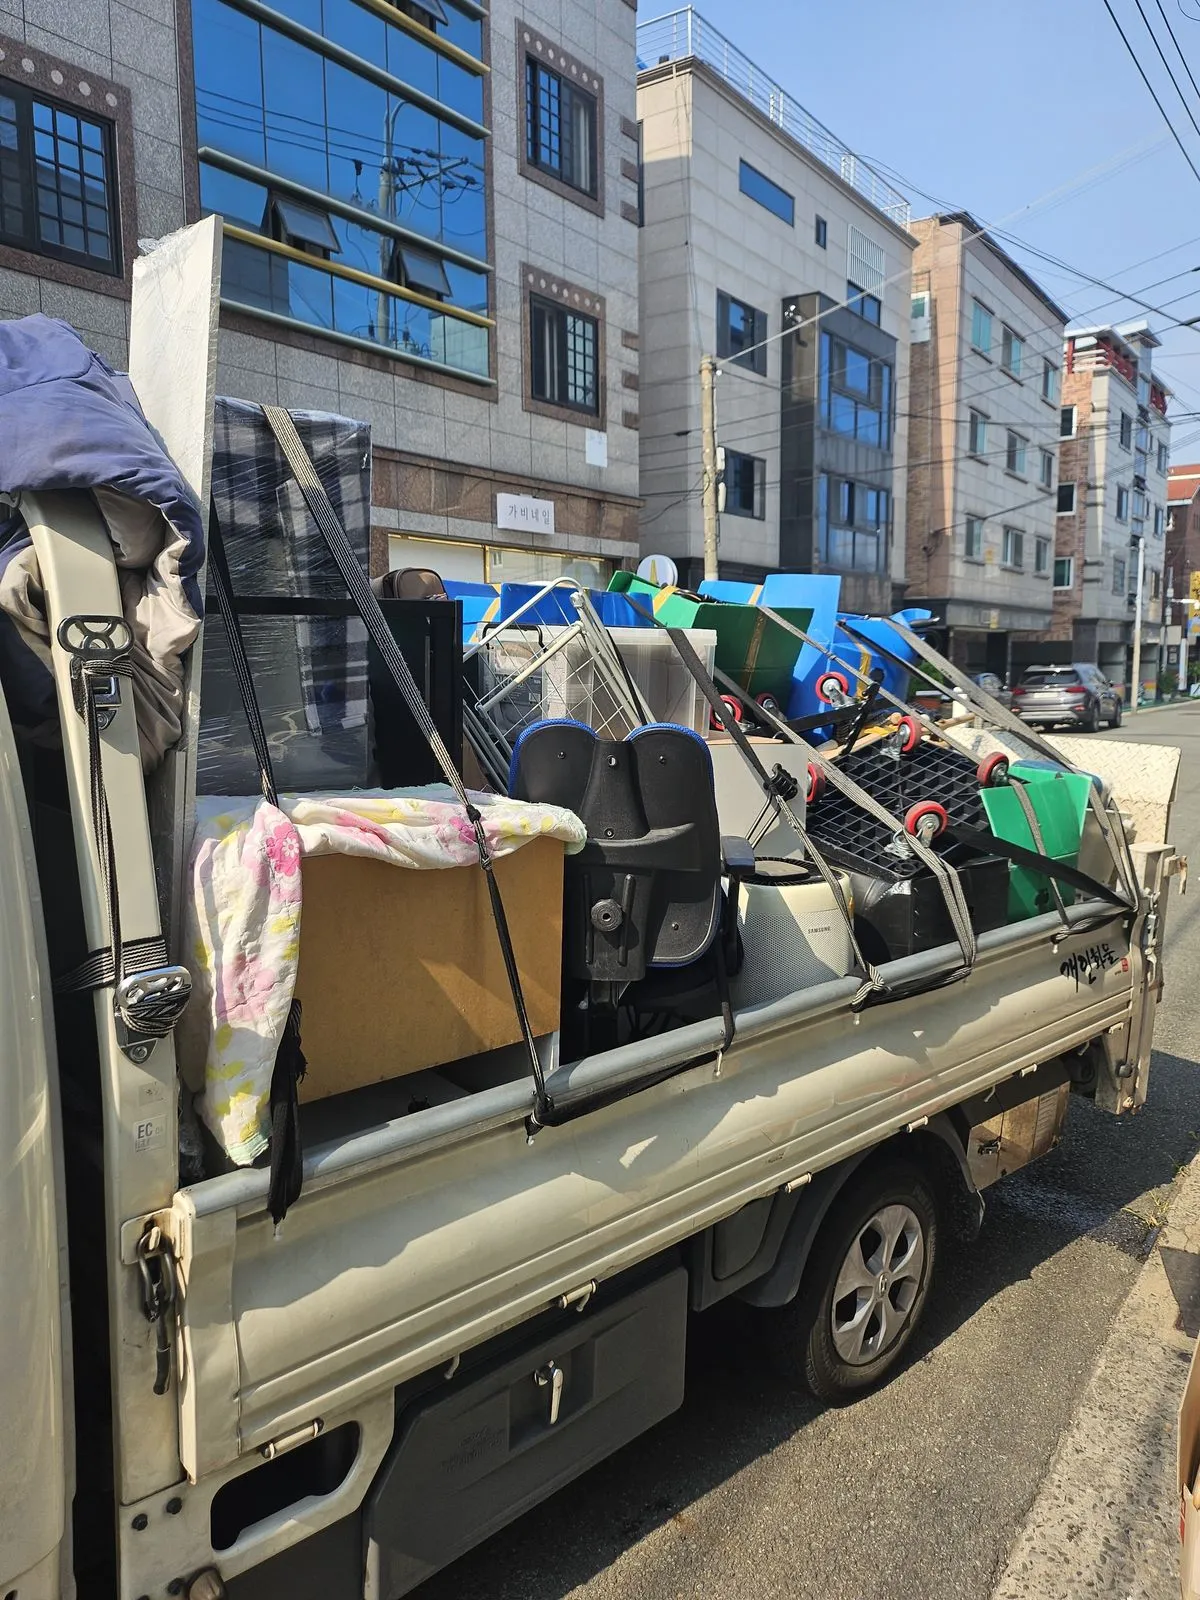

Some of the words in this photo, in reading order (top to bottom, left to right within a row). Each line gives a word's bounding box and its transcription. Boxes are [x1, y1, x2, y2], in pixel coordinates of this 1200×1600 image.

[508, 504, 551, 526] 가비네일
[807, 925, 831, 935] SAMSUNG
[1060, 943, 1120, 993] 개인화물
